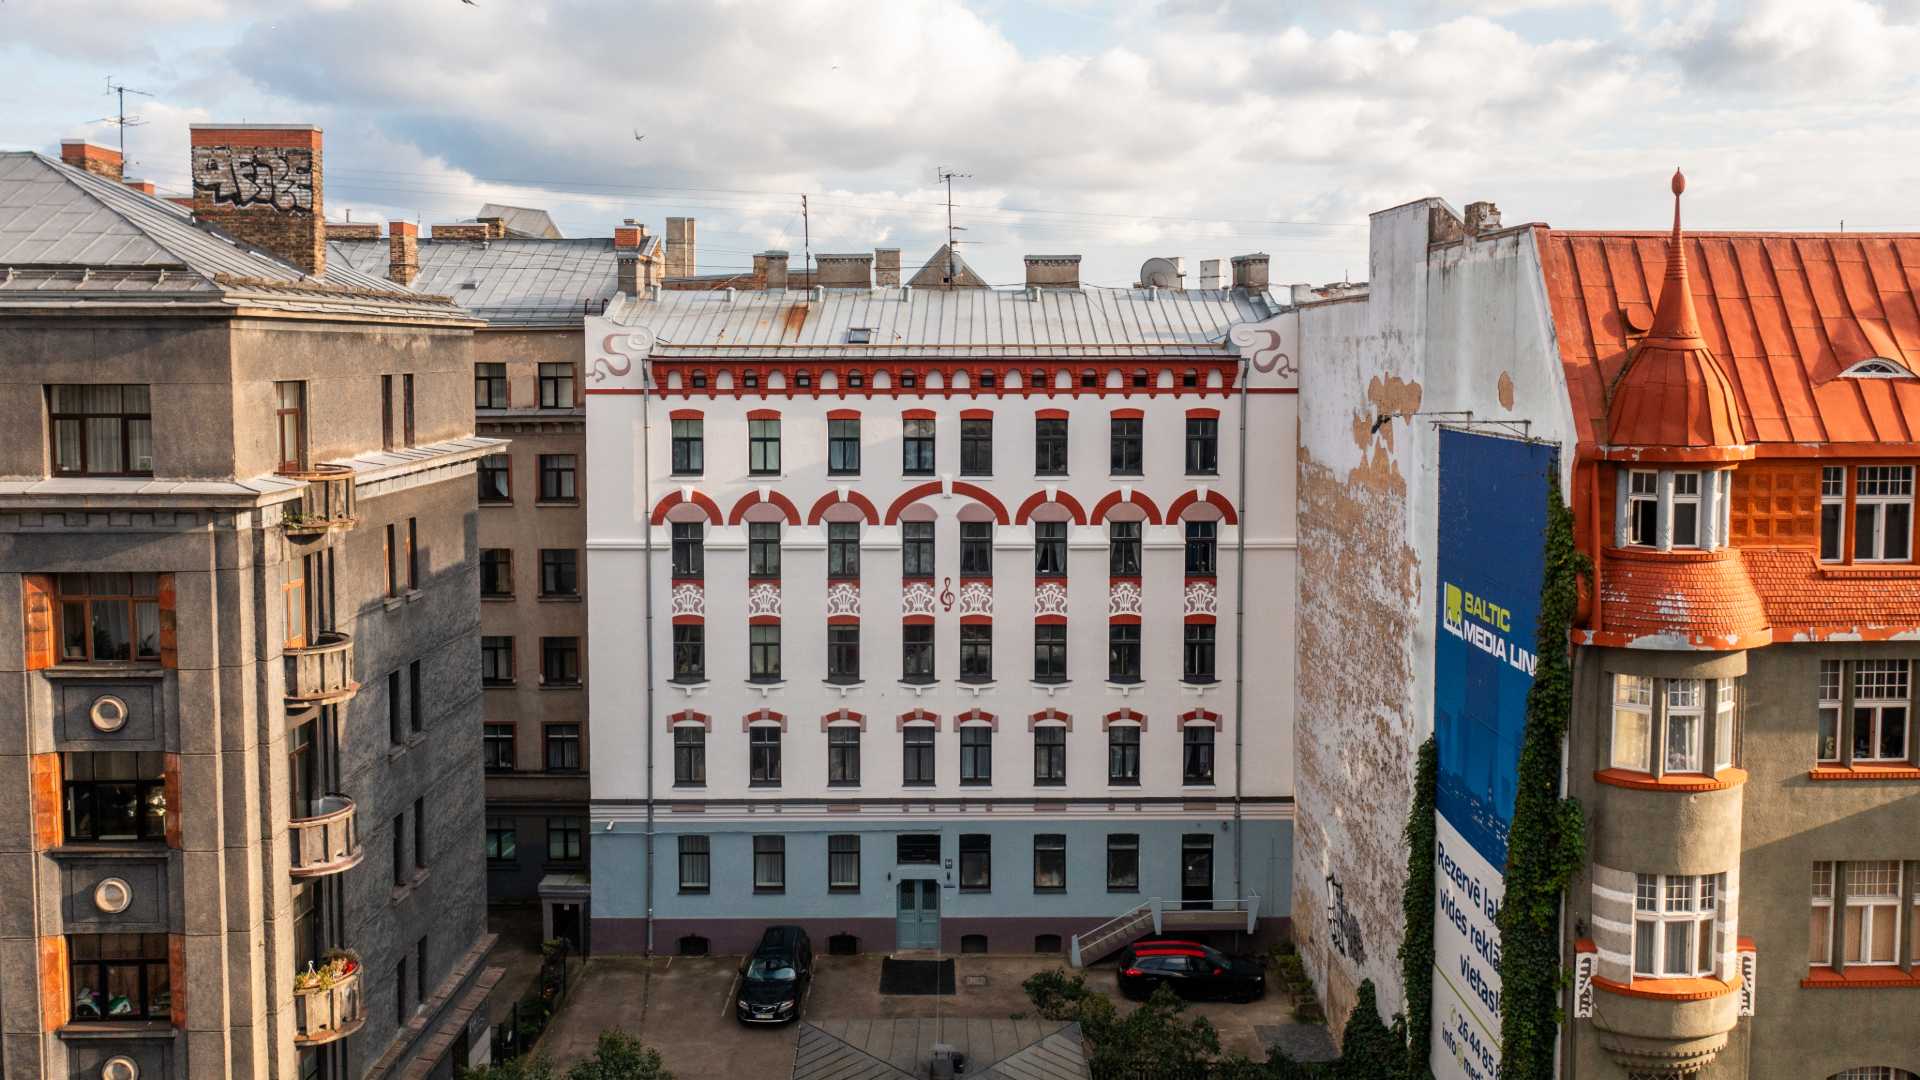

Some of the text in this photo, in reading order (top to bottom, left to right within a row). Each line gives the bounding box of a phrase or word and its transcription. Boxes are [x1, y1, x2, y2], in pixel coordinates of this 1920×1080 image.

[1464, 591, 1511, 633] BALTIC
[1463, 619, 1508, 663] MEDIA
[1437, 840, 1481, 909] Rezervē
[1440, 888, 1468, 937] vides
[1457, 1013, 1469, 1042] 26
[1469, 1031, 1481, 1060] 44
[1482, 1046, 1494, 1077] 85
